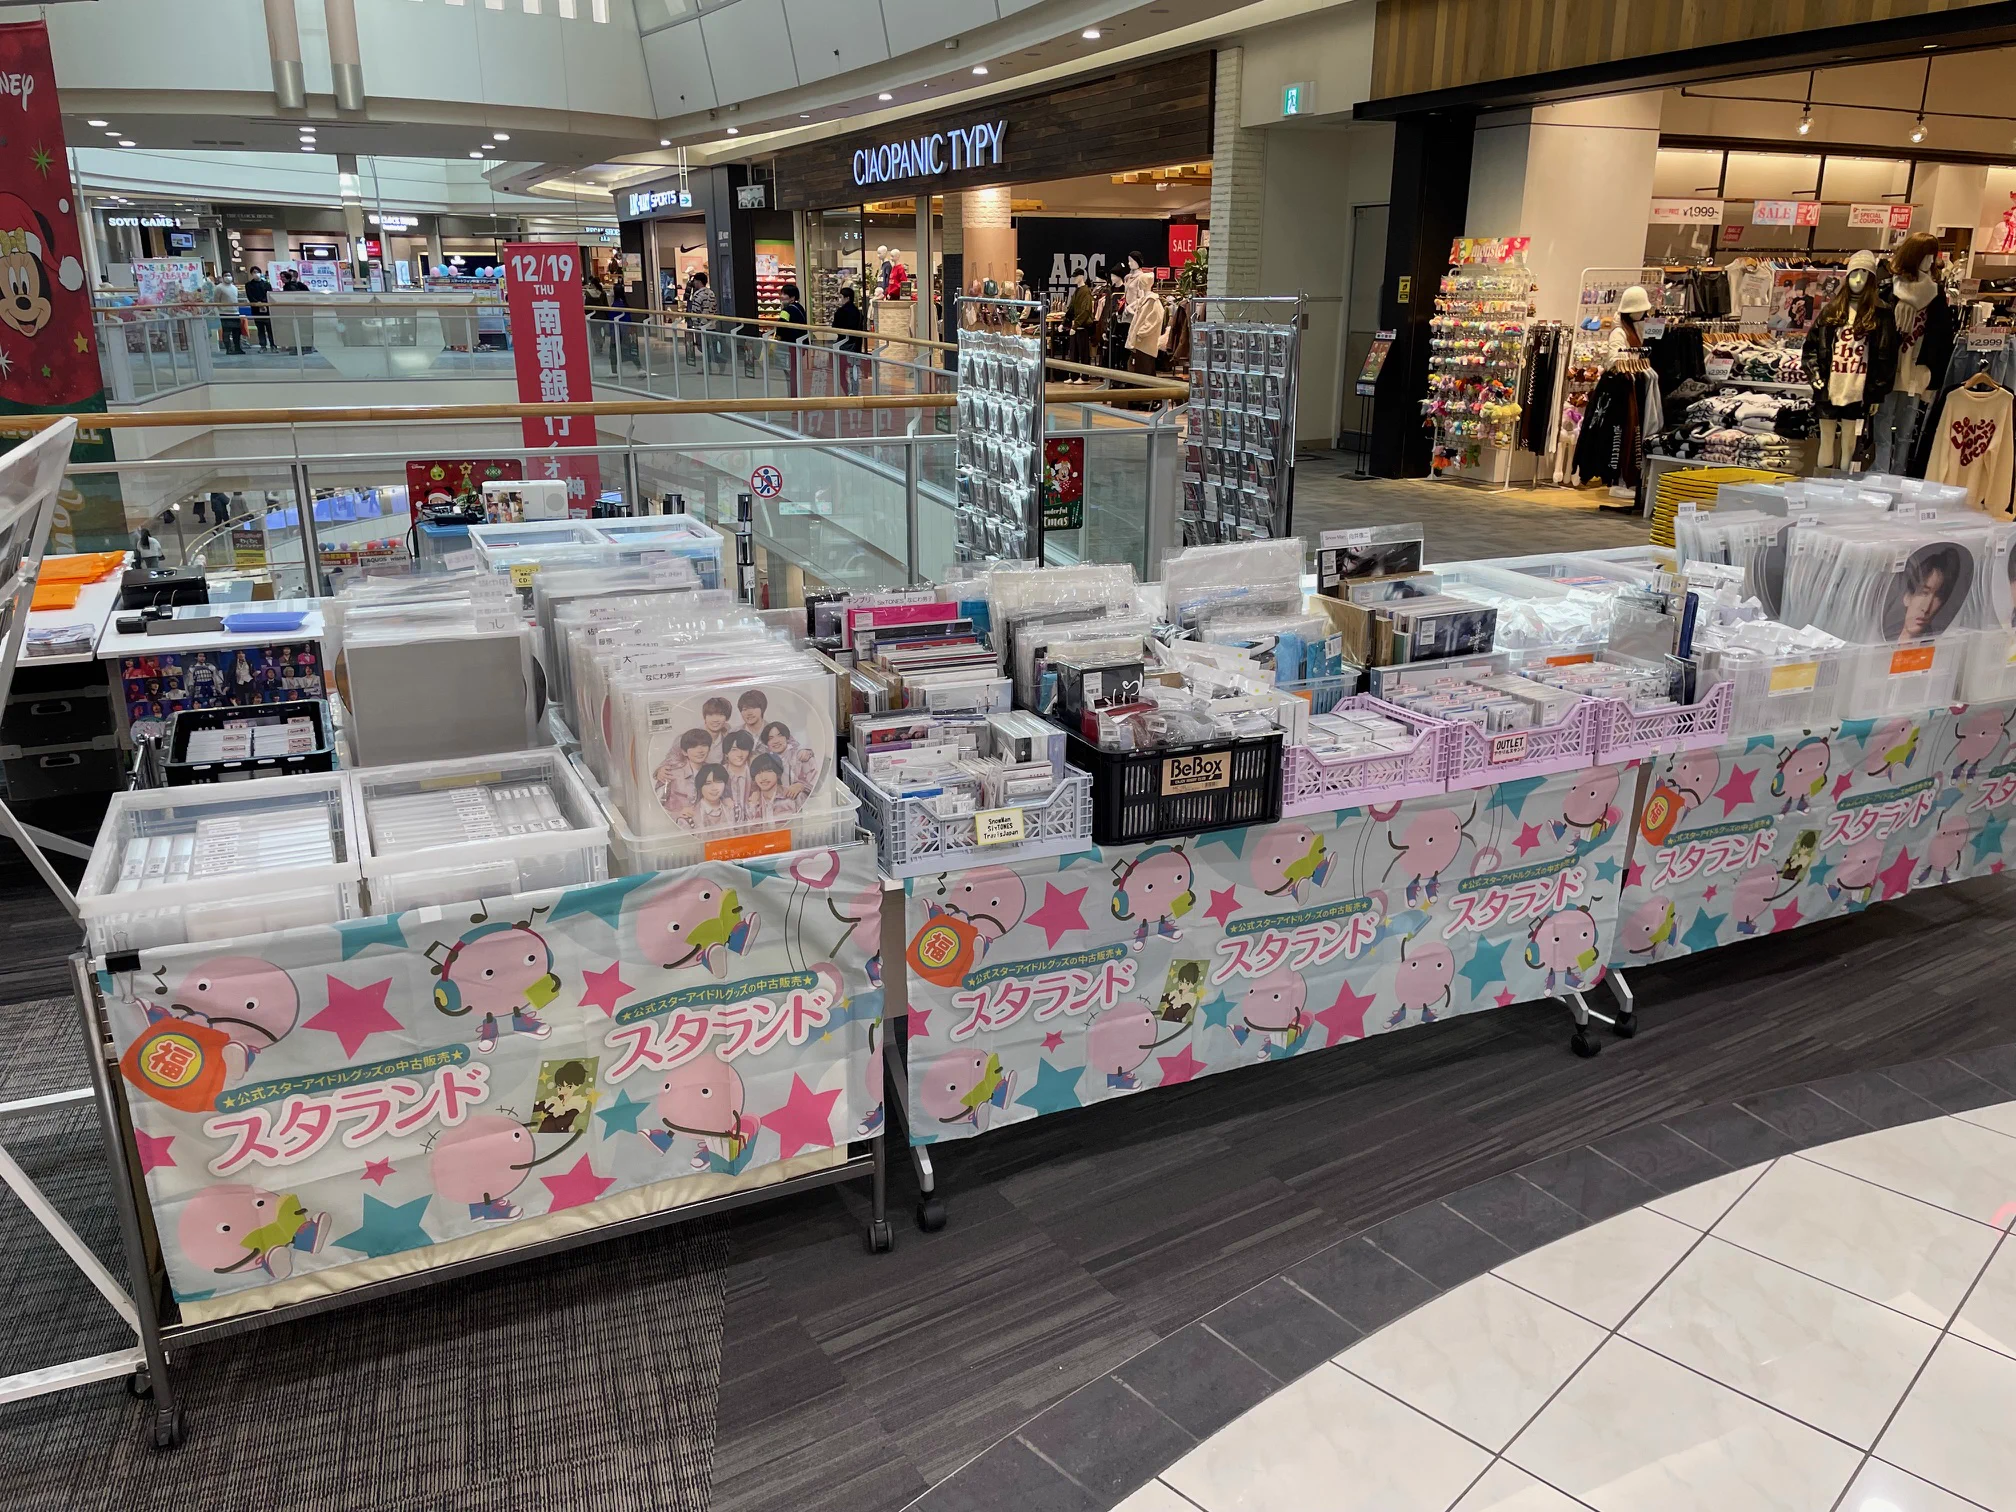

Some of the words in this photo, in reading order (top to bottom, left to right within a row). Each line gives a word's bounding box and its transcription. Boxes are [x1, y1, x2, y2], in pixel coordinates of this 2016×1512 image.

[0, 71, 35, 111] NEY
[853, 133, 944, 186] CIAOPANIC
[947, 120, 1007, 170] TYPY
[651, 190, 677, 208] SPORTS
[1757, 207, 1791, 219] SALE
[108, 217, 139, 227] SOYU
[141, 217, 174, 227] GAME
[1173, 239, 1193, 252] SALE
[1471, 243, 1508, 259] monster
[511, 254, 574, 282] 12/19
[533, 284, 555, 296] THU
[1833, 343, 1865, 359] the
[532, 299, 570, 437] 南都銀行
[1830, 358, 1867, 374] aith
[1043, 507, 1068, 515] onderful
[645, 671, 681, 681] なにわ男子
[1496, 737, 1524, 751] OUTLET
[1170, 756, 1223, 779] BeBox
[1822, 790, 1934, 846] スタランド
[1653, 831, 1776, 887] スタランド
[1446, 869, 1584, 936] スタランド
[922, 930, 957, 965] 福
[1214, 915, 1378, 981] スタランド
[954, 962, 1134, 1037] スタランド
[609, 992, 830, 1079] スタランド
[148, 1040, 197, 1083] 福
[209, 1066, 484, 1173] スタランド
